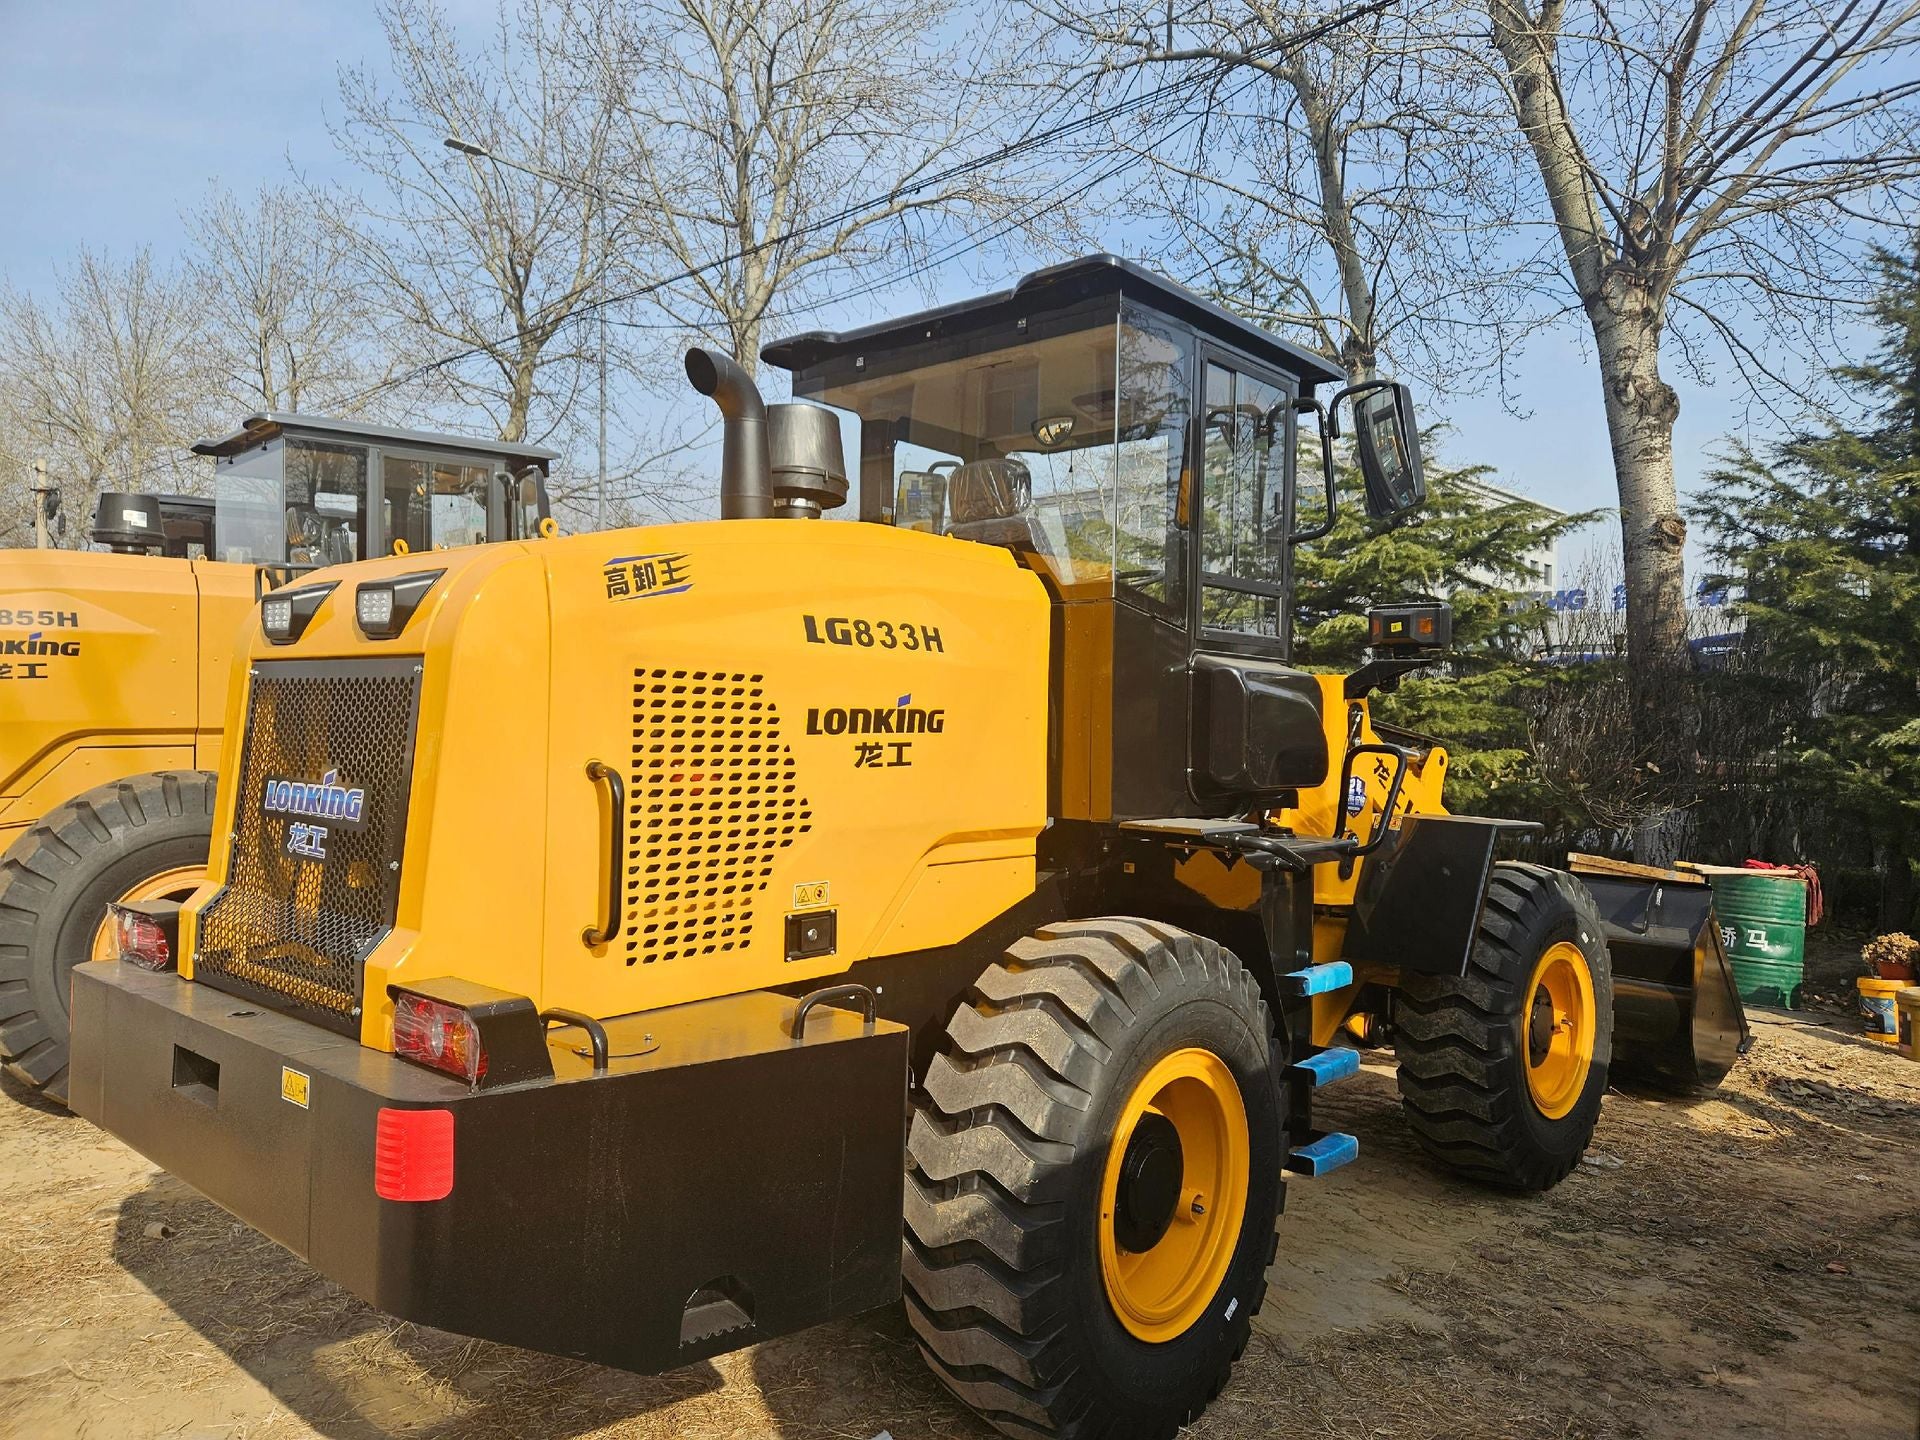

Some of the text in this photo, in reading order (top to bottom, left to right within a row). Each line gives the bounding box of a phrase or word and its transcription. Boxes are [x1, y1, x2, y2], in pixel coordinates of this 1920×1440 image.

[603, 553, 693, 599] 高卸王
[0, 609, 79, 627] 855H
[802, 614, 945, 653] LG833H
[806, 694, 945, 735] LONKING
[853, 741, 913, 768] 龙工
[264, 769, 365, 822] LONKING
[287, 822, 328, 859] 龙工
